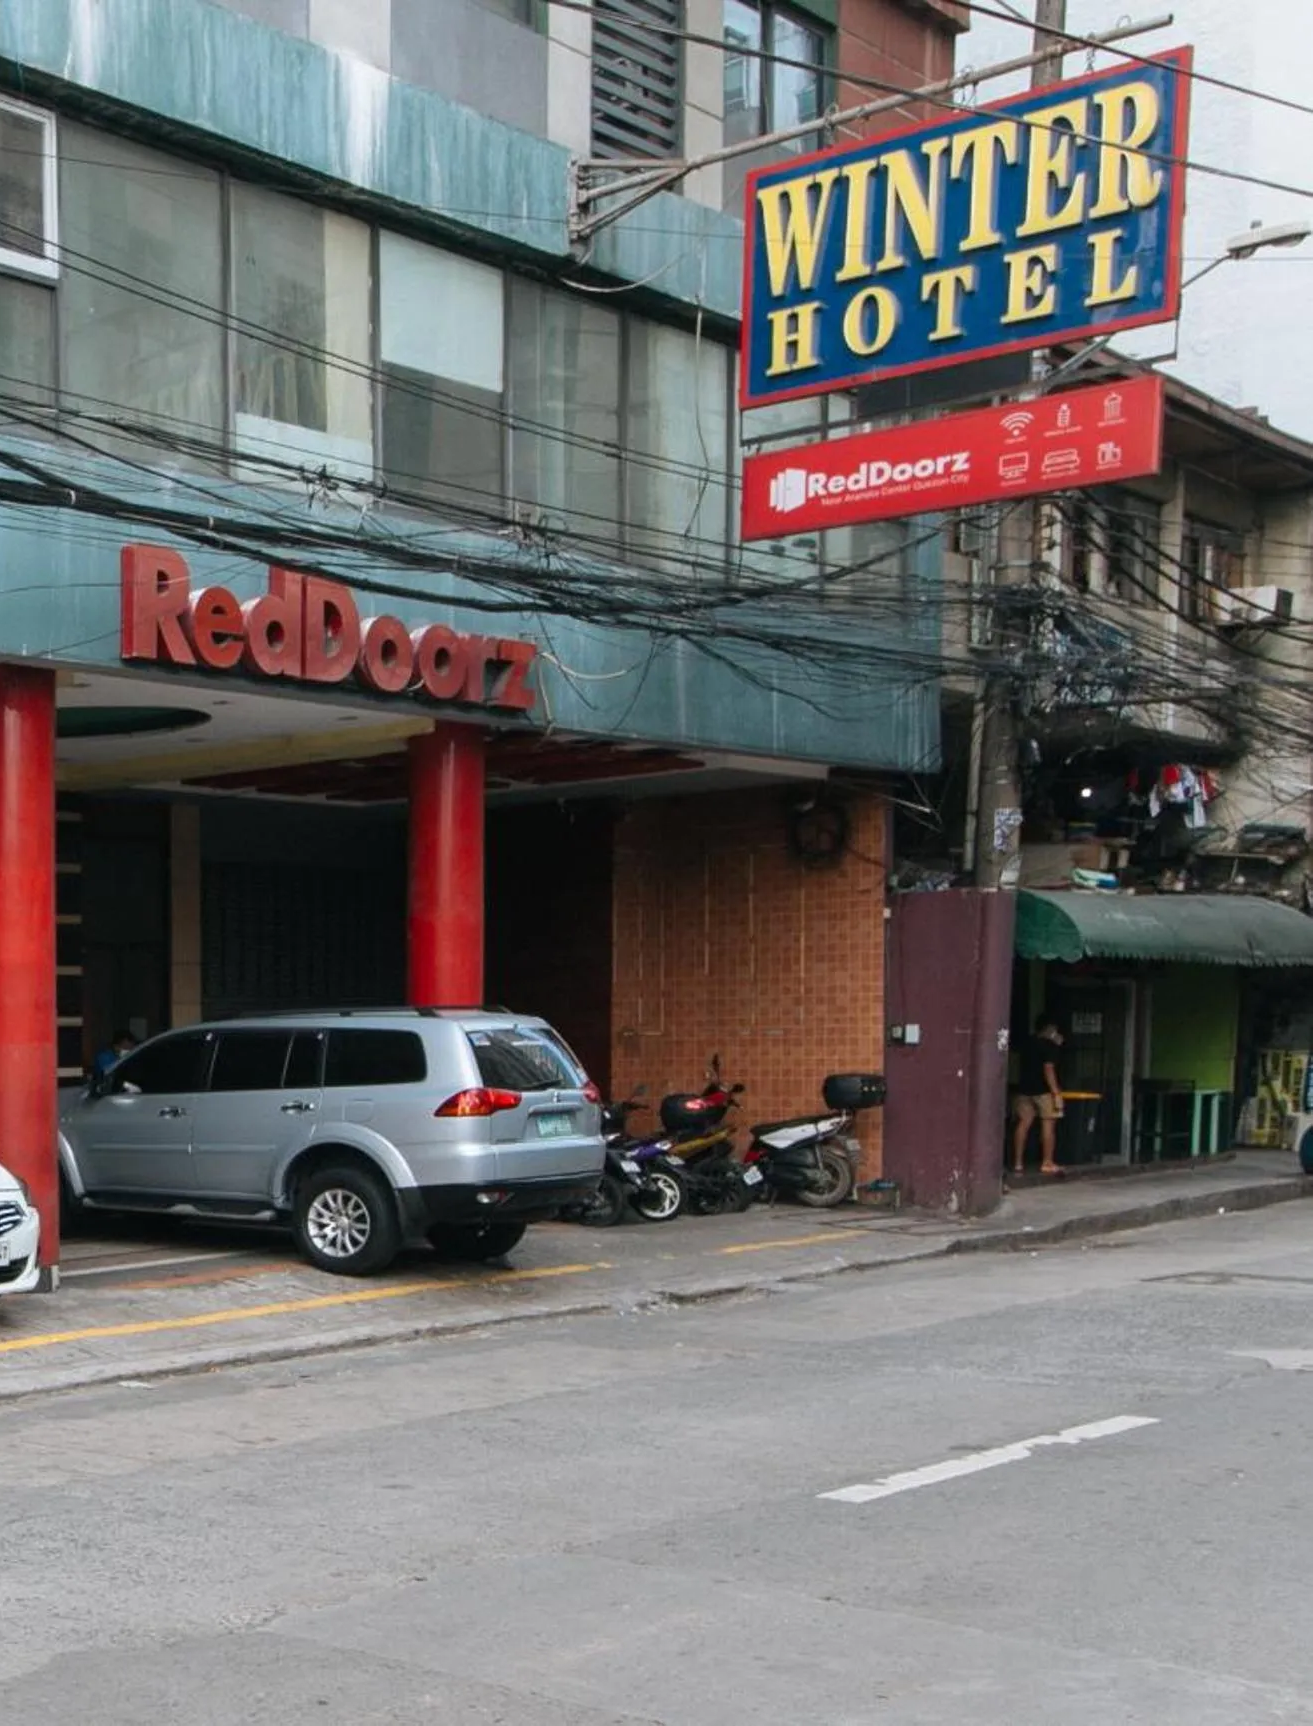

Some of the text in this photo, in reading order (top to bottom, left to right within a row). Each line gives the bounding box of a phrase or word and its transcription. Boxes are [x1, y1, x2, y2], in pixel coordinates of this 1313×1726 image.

[756, 81, 1165, 299] WINTER
[765, 229, 1138, 377] HOTEL
[807, 451, 971, 498] RedDoorz
[120, 542, 538, 711] RedDoorz
